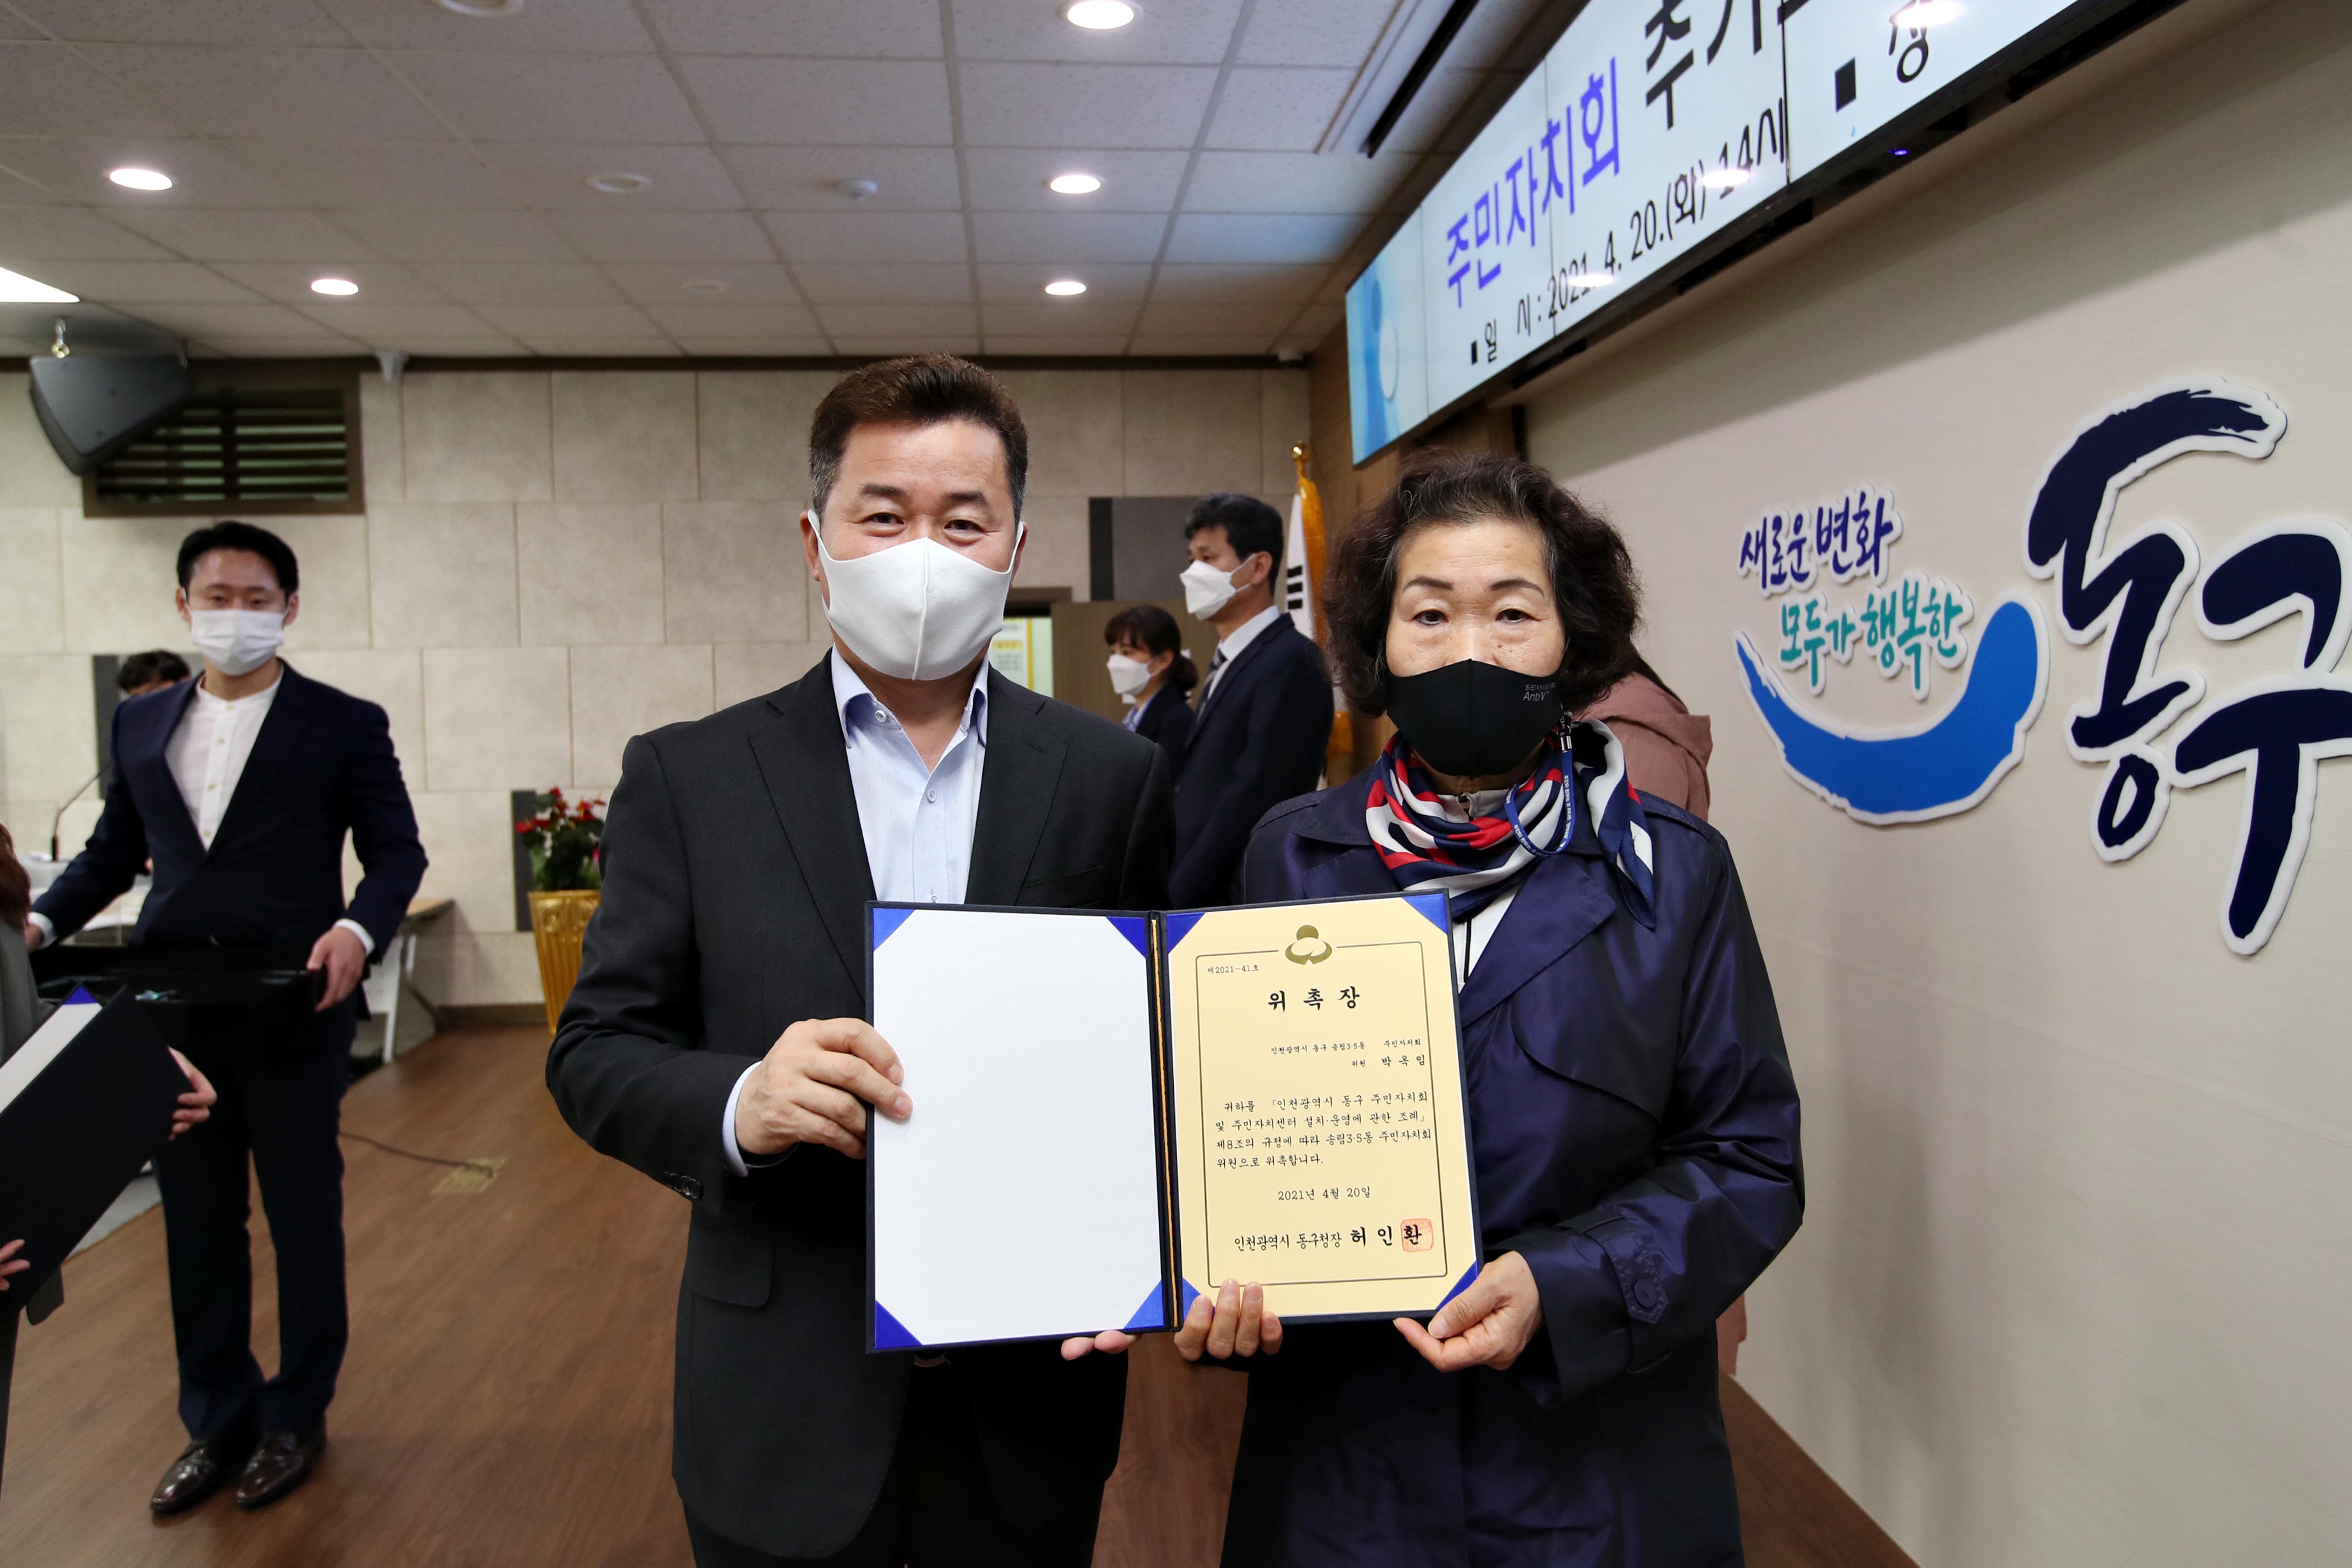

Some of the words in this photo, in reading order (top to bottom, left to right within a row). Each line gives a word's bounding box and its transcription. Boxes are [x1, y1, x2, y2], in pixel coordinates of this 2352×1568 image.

[1719, 97, 1784, 200] 14시
[1447, 56, 1620, 309] 주민자치회
[1740, 515, 1810, 590] 새로운
[1816, 491, 1893, 578] 변화
[1781, 597, 1854, 686] 모두가
[1860, 579, 1963, 690] 행복한
[2028, 389, 2352, 939] 동구
[1271, 1045, 1308, 1055] 인천광역시
[1312, 1044, 1327, 1053] 동구
[1383, 1038, 1421, 1048] 주민자치회
[1352, 1059, 1366, 1068] 위원
[1224, 1100, 1255, 1113] 귀하를
[1341, 1095, 1363, 1107] 동구
[1370, 1090, 1427, 1105] 주민자치회
[1215, 1120, 1224, 1132] 및
[1232, 1116, 1296, 1131] 주민자치센터
[1369, 1111, 1391, 1124] 관한
[1216, 1137, 1254, 1150] 제8조의
[1262, 1135, 1292, 1148] 규정에
[1299, 1134, 1320, 1146] 따라
[1379, 1128, 1431, 1142] 주민자치회
[1217, 1157, 1260, 1170] 위원으로
[1266, 1153, 1324, 1167] 위촉합니다.
[1278, 1188, 1314, 1201] 2021년
[1322, 1187, 1339, 1200] 4월
[1347, 1186, 1370, 1198] 20일
[1235, 1234, 1290, 1252] 인천광역시
[1296, 1231, 1342, 1249] 동구청장
